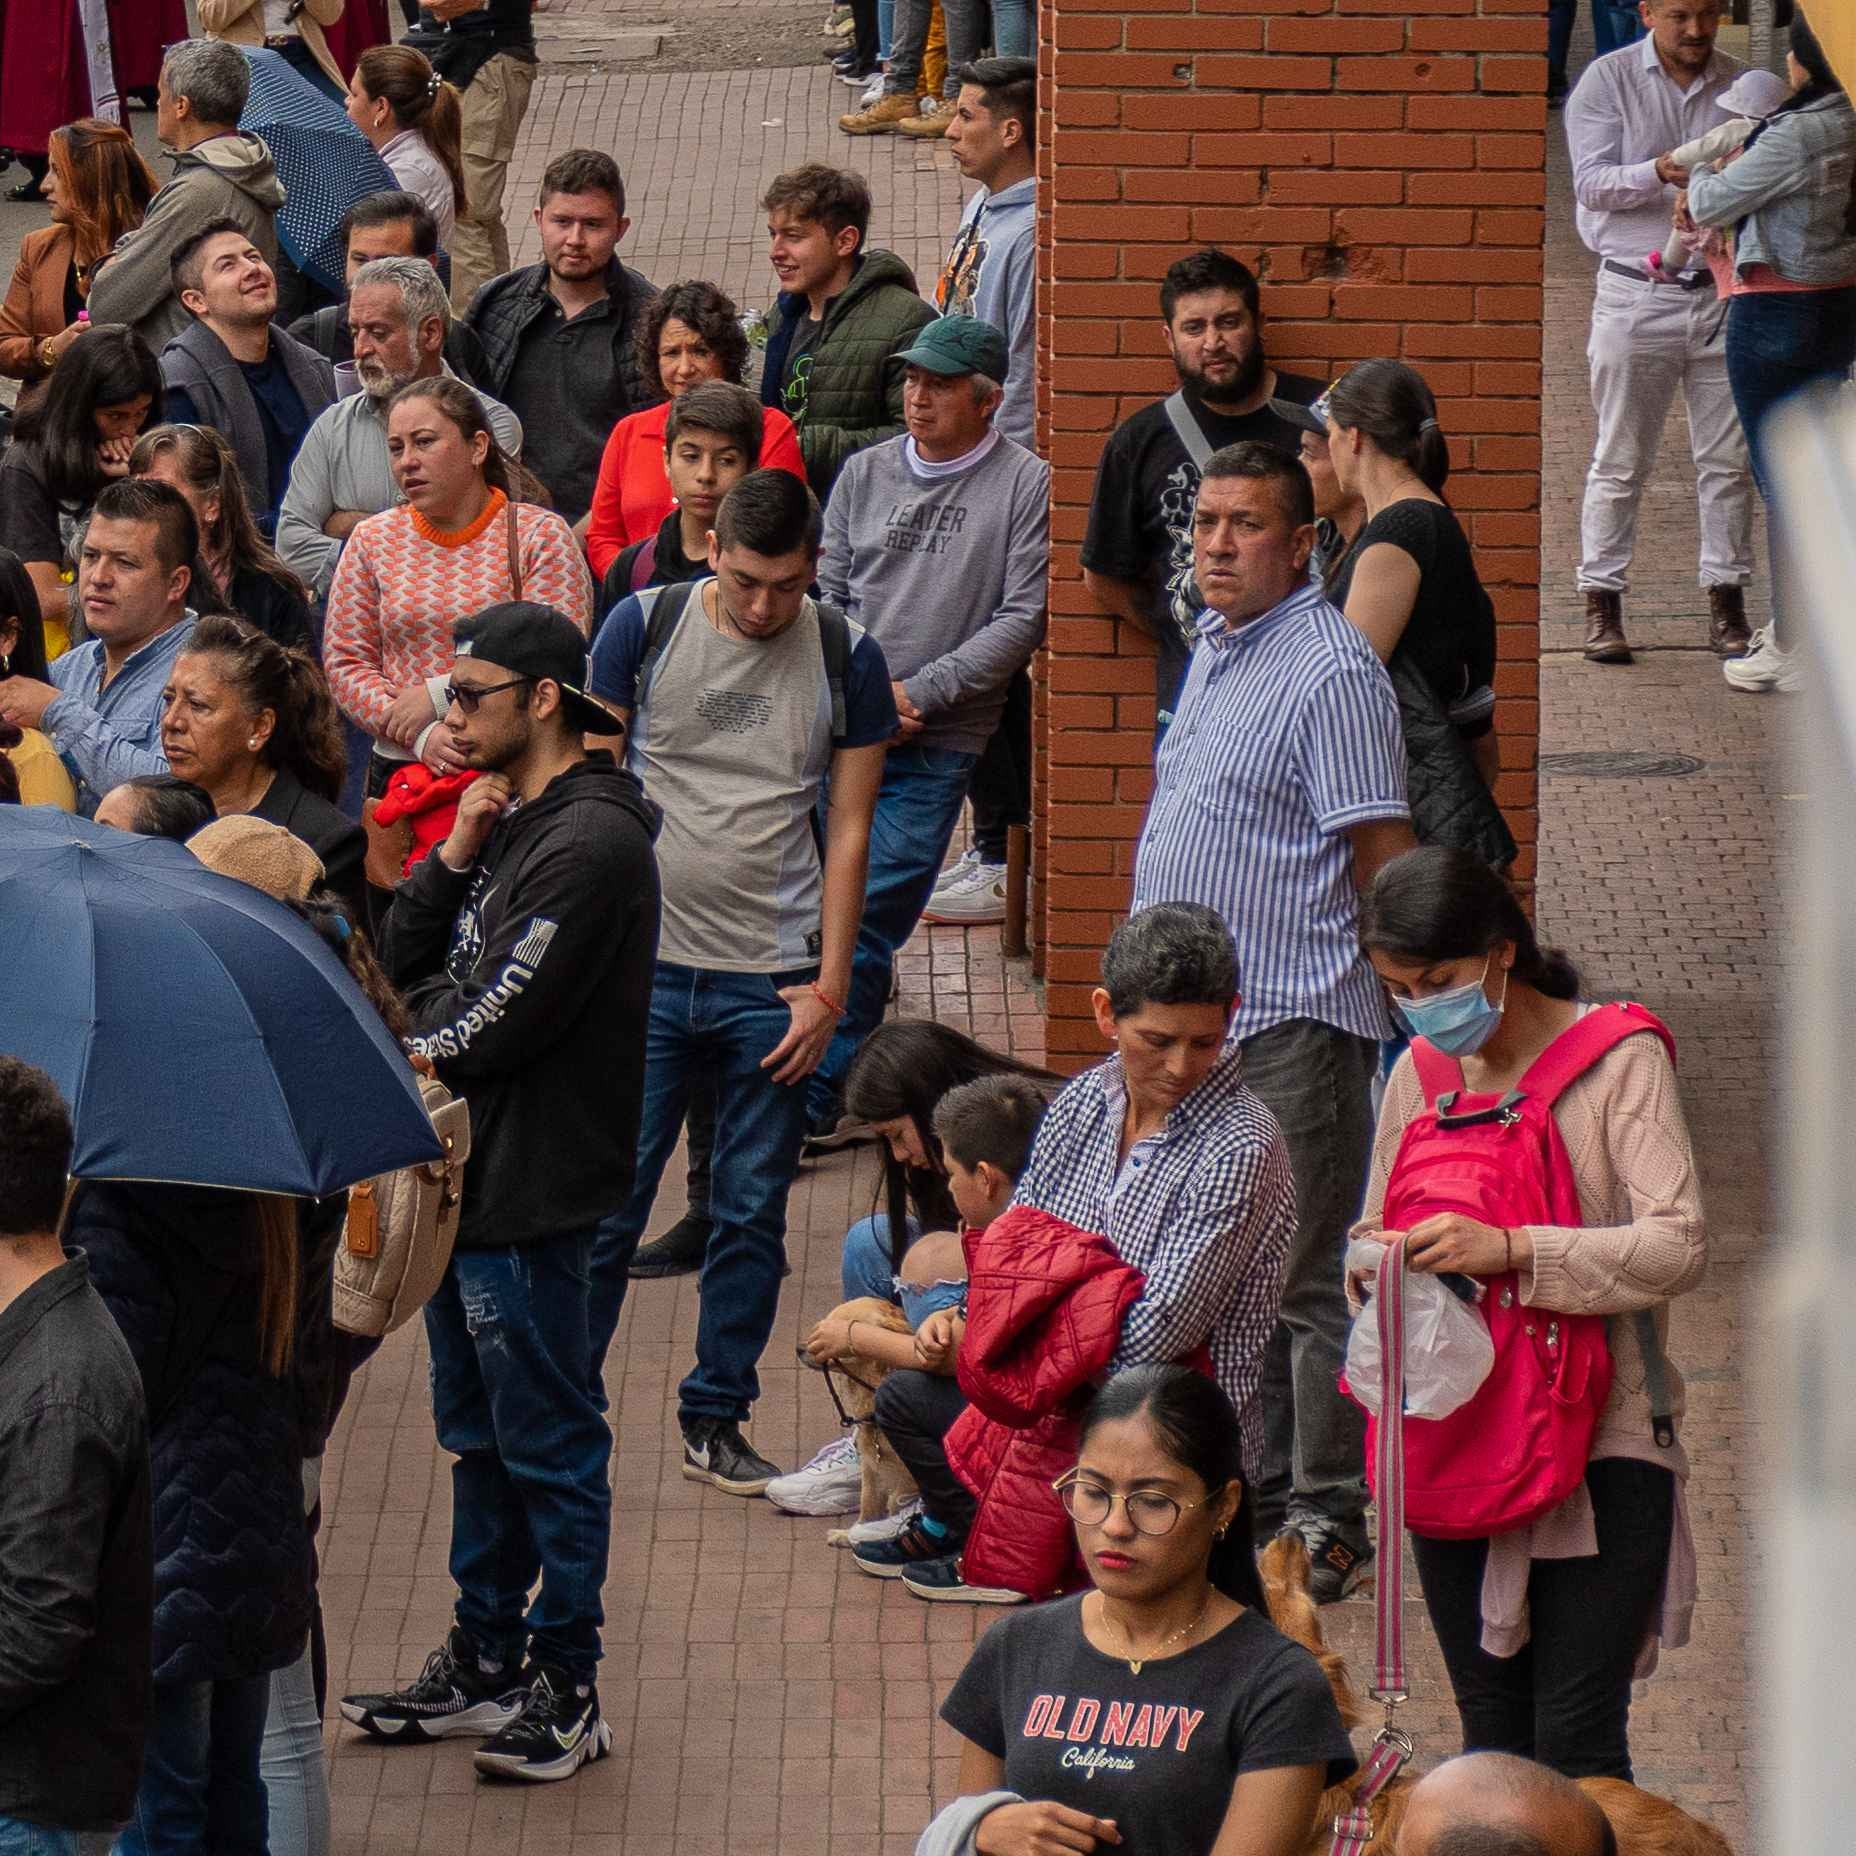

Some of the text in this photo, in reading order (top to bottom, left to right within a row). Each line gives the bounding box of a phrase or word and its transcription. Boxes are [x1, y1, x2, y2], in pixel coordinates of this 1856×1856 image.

[885, 504, 968, 533] LEADER
[884, 530, 952, 554] REPLAY
[456, 963, 534, 1049] United
[1023, 1694, 1205, 1752] OLD NAVY
[1061, 1746, 1136, 1780] California
